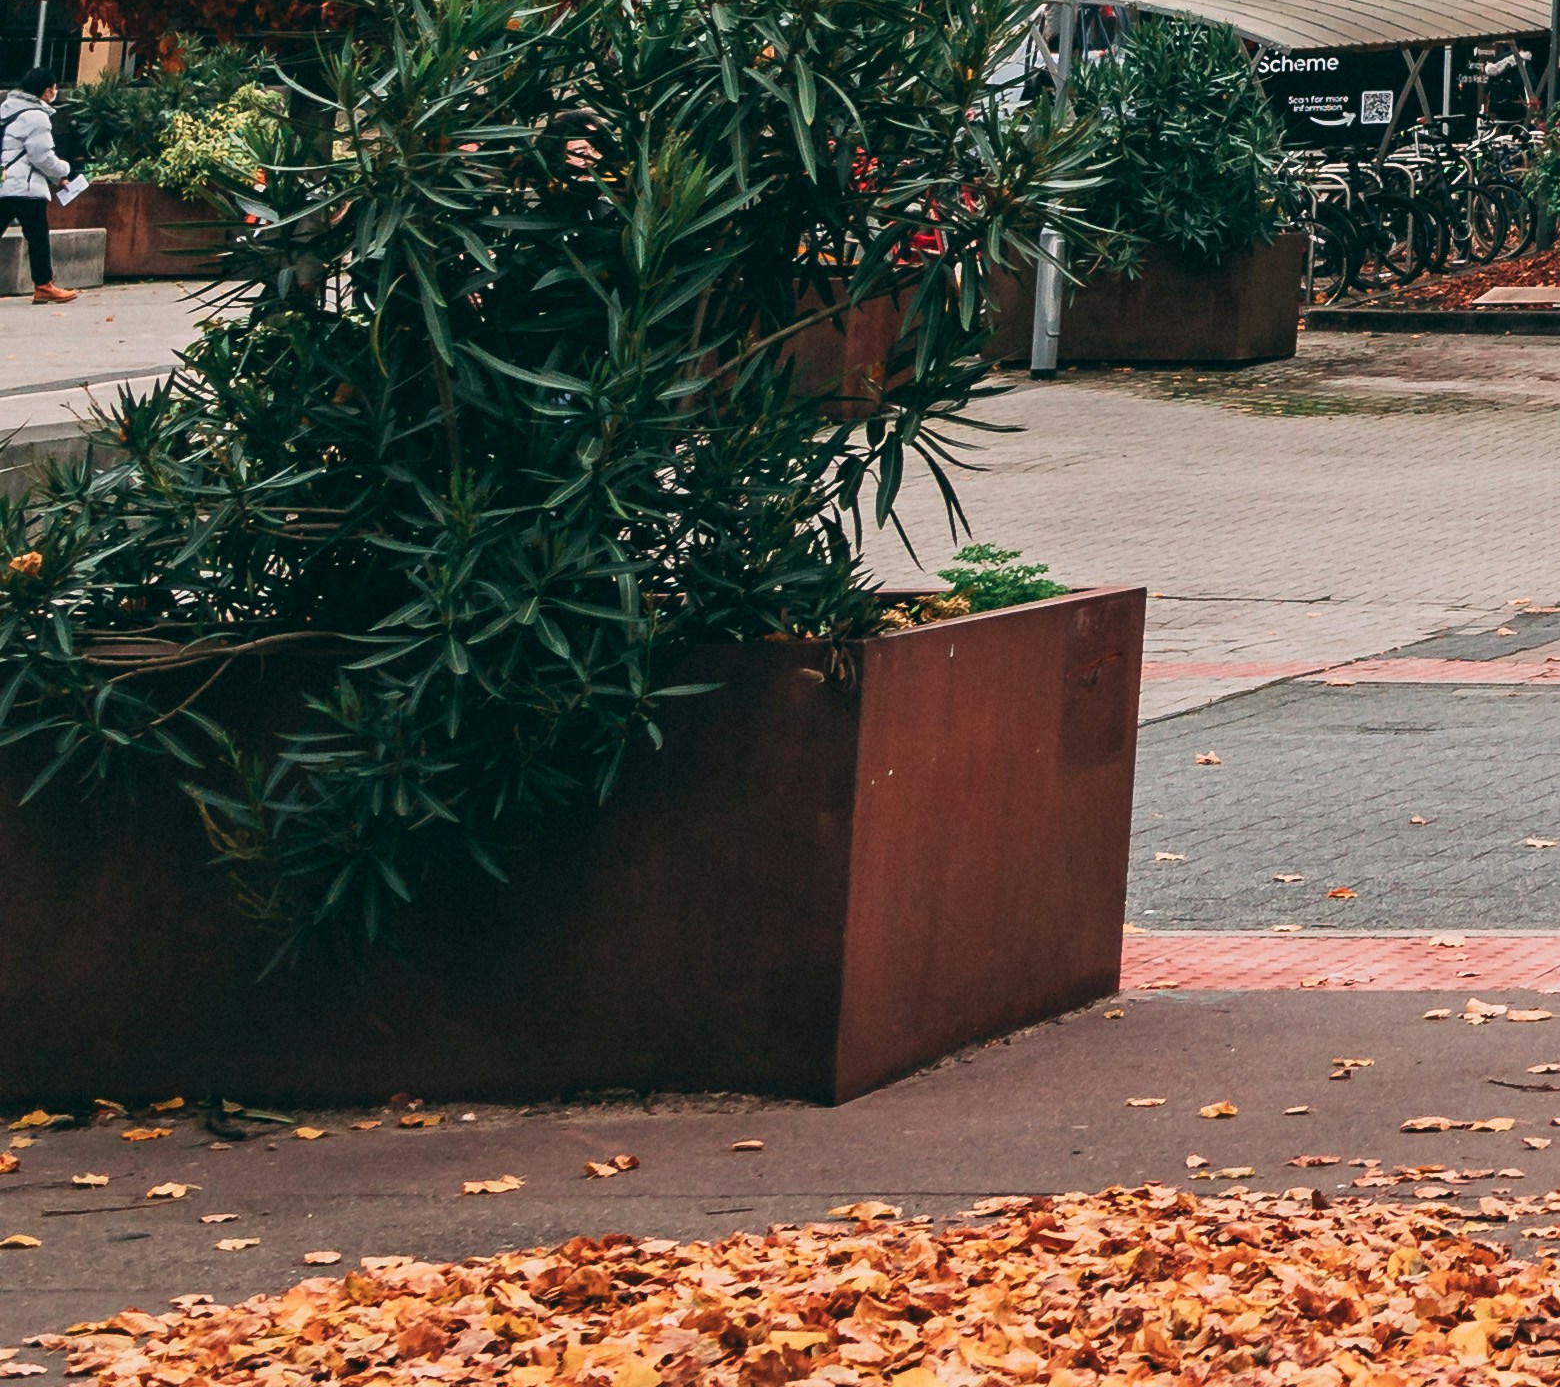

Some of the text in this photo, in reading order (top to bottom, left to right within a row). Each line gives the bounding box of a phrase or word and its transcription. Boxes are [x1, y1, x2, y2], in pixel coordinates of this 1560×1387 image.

[1257, 55, 1340, 74] Scheme
[1288, 95, 1309, 105] Scan
[1310, 95, 1323, 104] for
[1293, 104, 1343, 112] information
